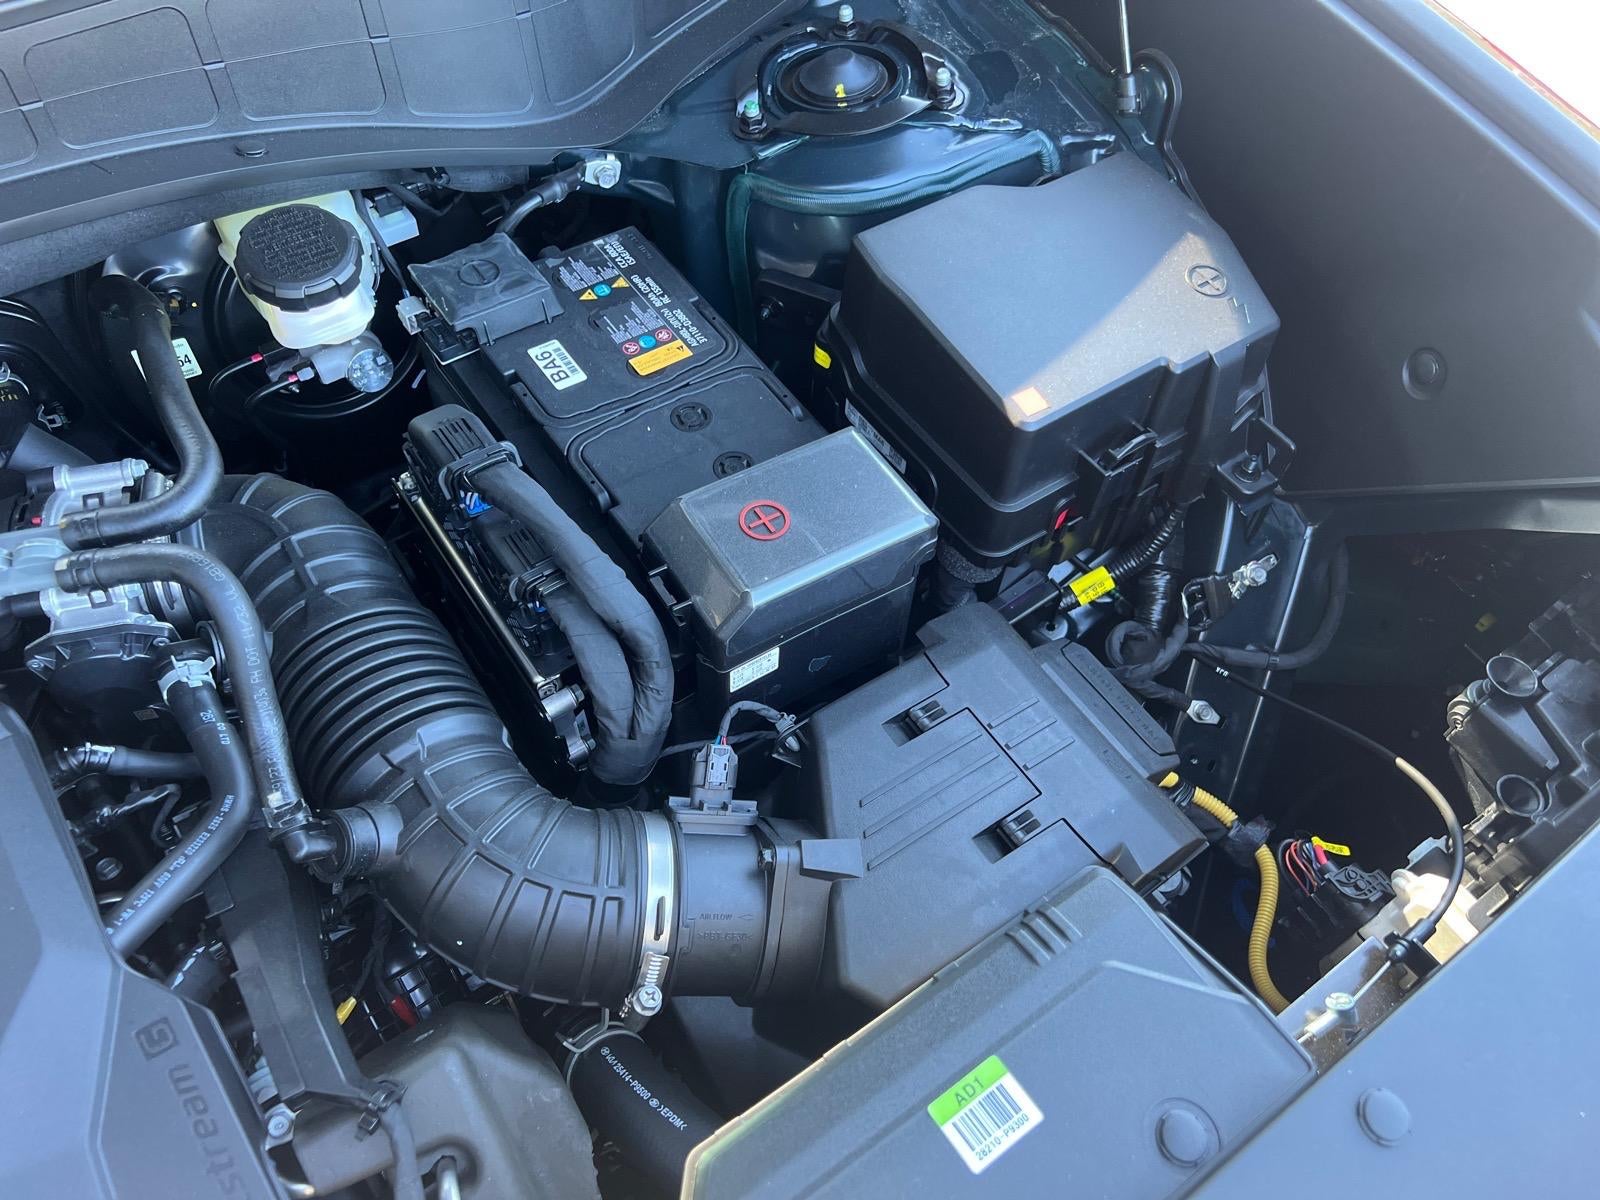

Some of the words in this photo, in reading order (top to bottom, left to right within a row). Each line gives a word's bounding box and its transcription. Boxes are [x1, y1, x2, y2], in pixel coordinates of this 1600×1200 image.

[604, 243, 619, 258] 800A
[615, 255, 629, 269] CCA
[630, 274, 651, 294] (20HR)
[659, 294, 672, 305] RC
[535, 350, 571, 383] BA6
[613, 1062, 652, 1101] 25414-P9500
[954, 1077, 985, 1108] AD1
[168, 1062, 248, 1198] stream
[975, 1112, 1030, 1161] 28210-P9300
